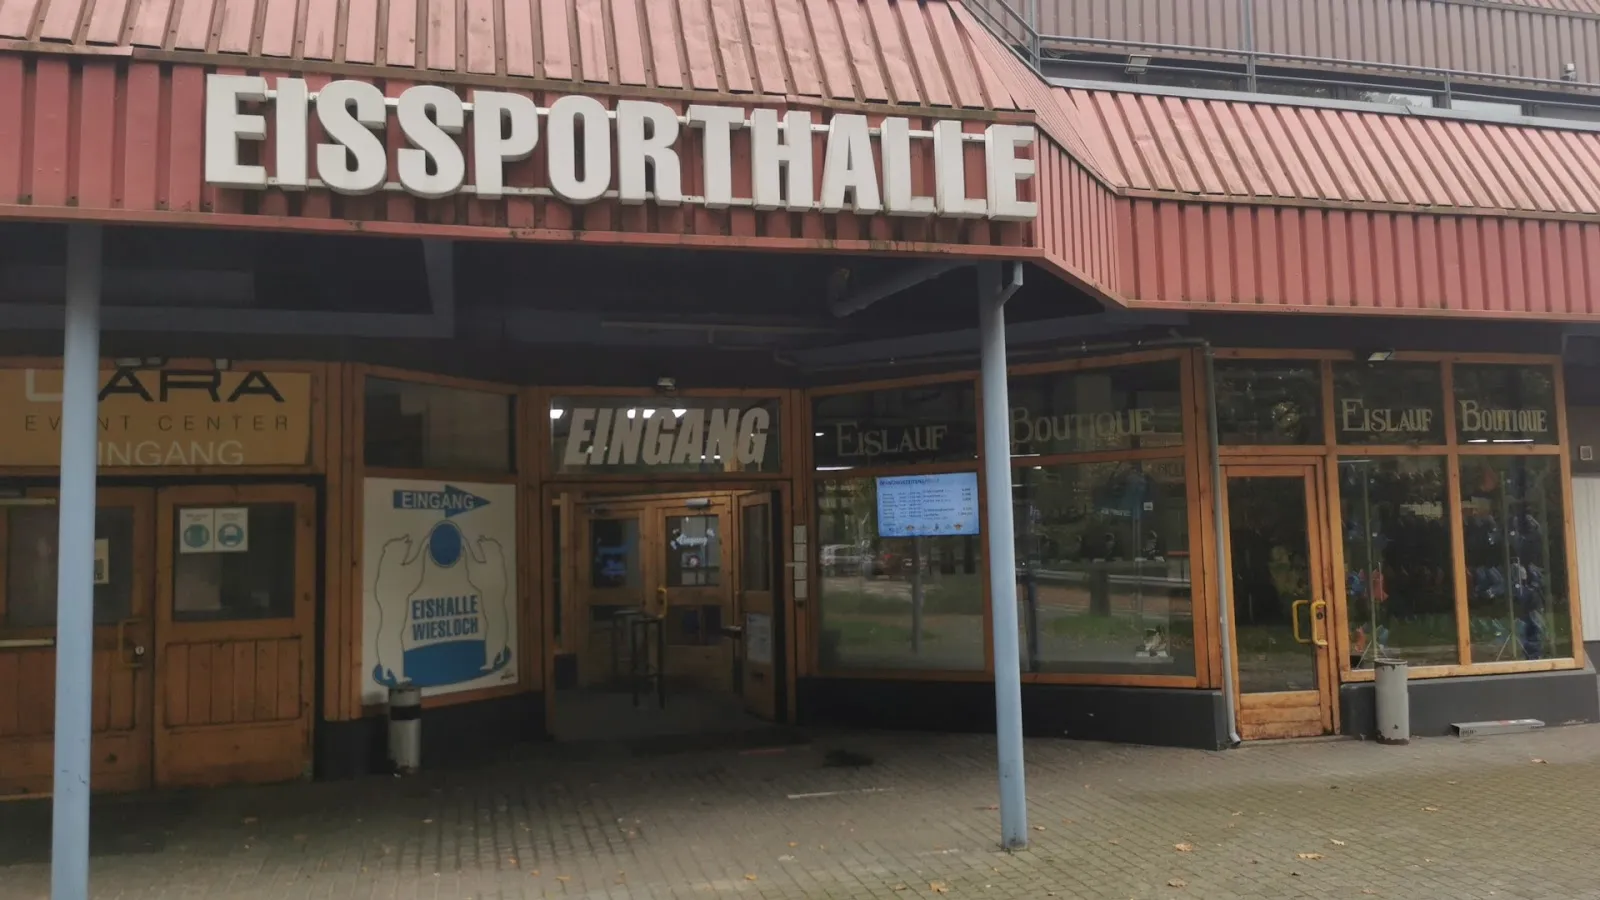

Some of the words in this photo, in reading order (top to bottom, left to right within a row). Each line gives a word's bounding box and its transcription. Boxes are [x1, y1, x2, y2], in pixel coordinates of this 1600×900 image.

[205, 73, 1037, 221] EISSPORTHALLE
[25, 414, 132, 432] EVNT
[158, 414, 288, 431] CENTER
[564, 407, 770, 466] EINGANG
[97, 440, 244, 467] INGANG
[401, 491, 475, 510] EINGANG
[411, 595, 479, 621] EISHALLE
[412, 617, 479, 641] WIESLOCH
